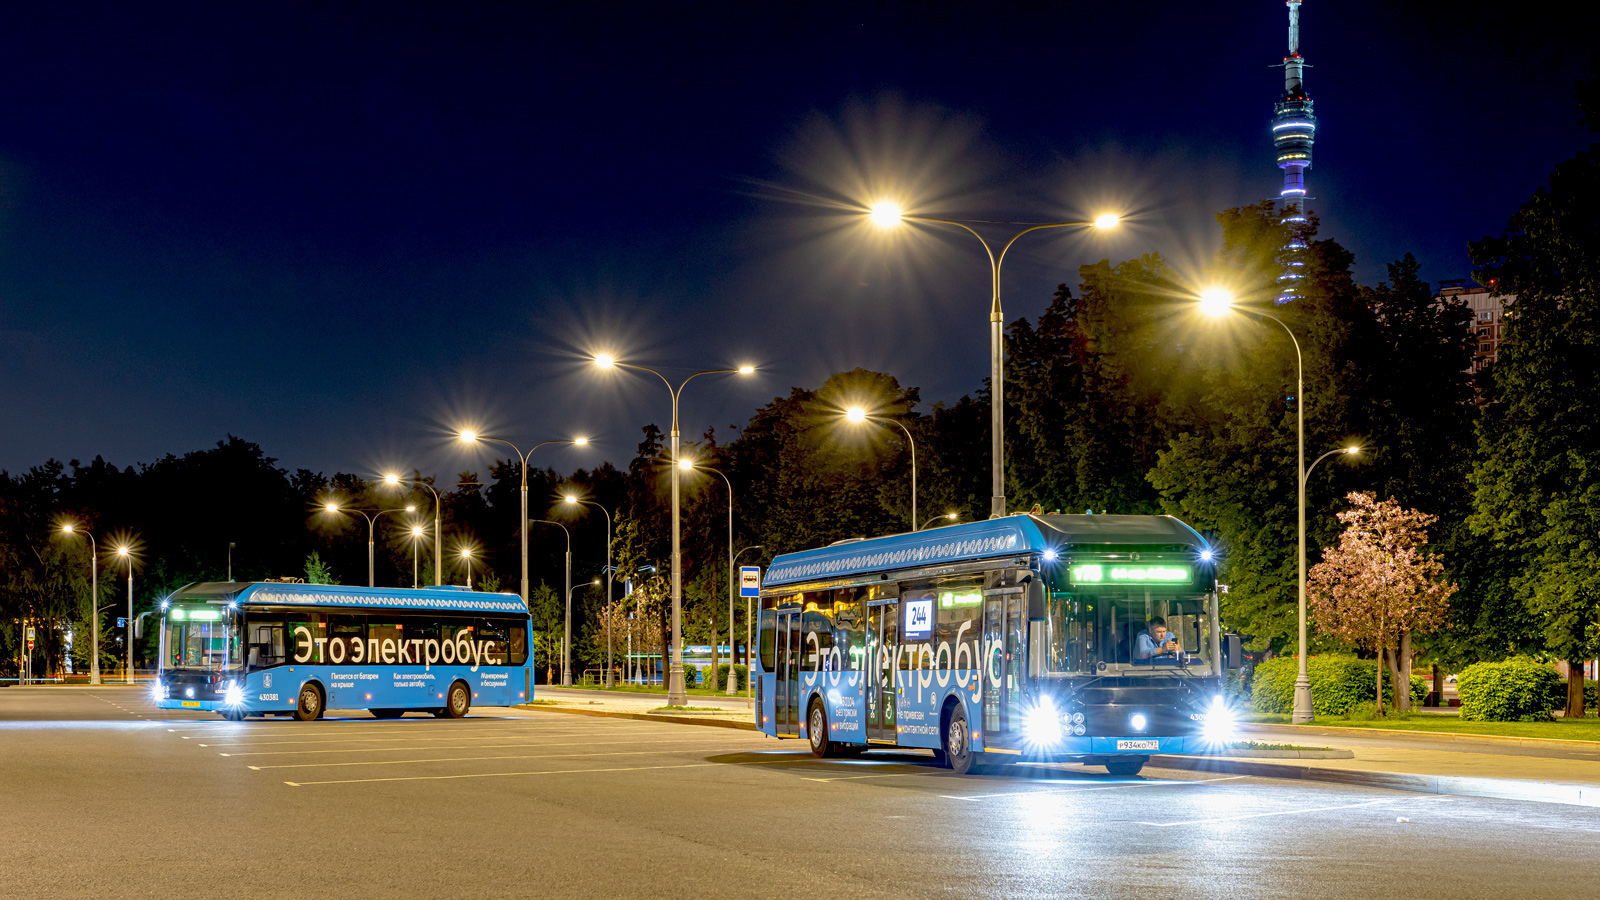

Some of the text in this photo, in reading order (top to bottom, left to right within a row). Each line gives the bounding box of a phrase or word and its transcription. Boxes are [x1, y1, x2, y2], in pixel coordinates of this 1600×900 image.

[912, 606, 926, 625] 244
[294, 626, 502, 672] Это электробус.
[805, 631, 842, 687] Это
[331, 672, 353, 680] Питается
[359, 672, 379, 681] батареи
[393, 672, 401, 680] Как
[481, 672, 508, 680] Маневренный
[484, 680, 506, 688] бесшумный
[259, 693, 279, 701] 430381
[904, 710, 925, 722] привязан
